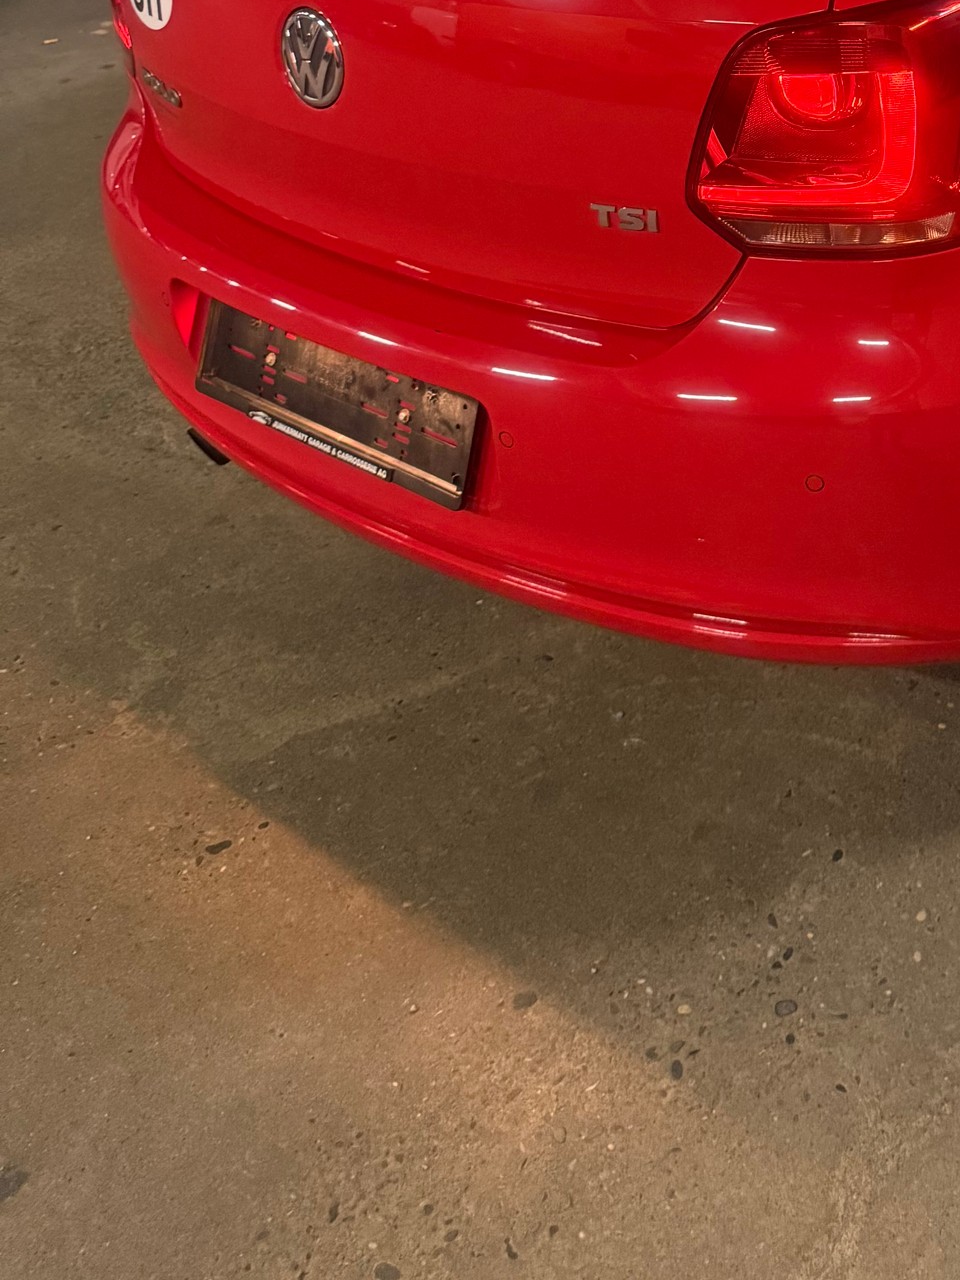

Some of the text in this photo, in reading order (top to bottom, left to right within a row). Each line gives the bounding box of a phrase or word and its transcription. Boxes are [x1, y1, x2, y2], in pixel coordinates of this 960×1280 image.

[284, 10, 343, 106] VW
[590, 203, 659, 233] TSI
[307, 437, 332, 454] GARAGE
[337, 450, 378, 474] CARROSSERIE
[377, 468, 387, 479] AG
